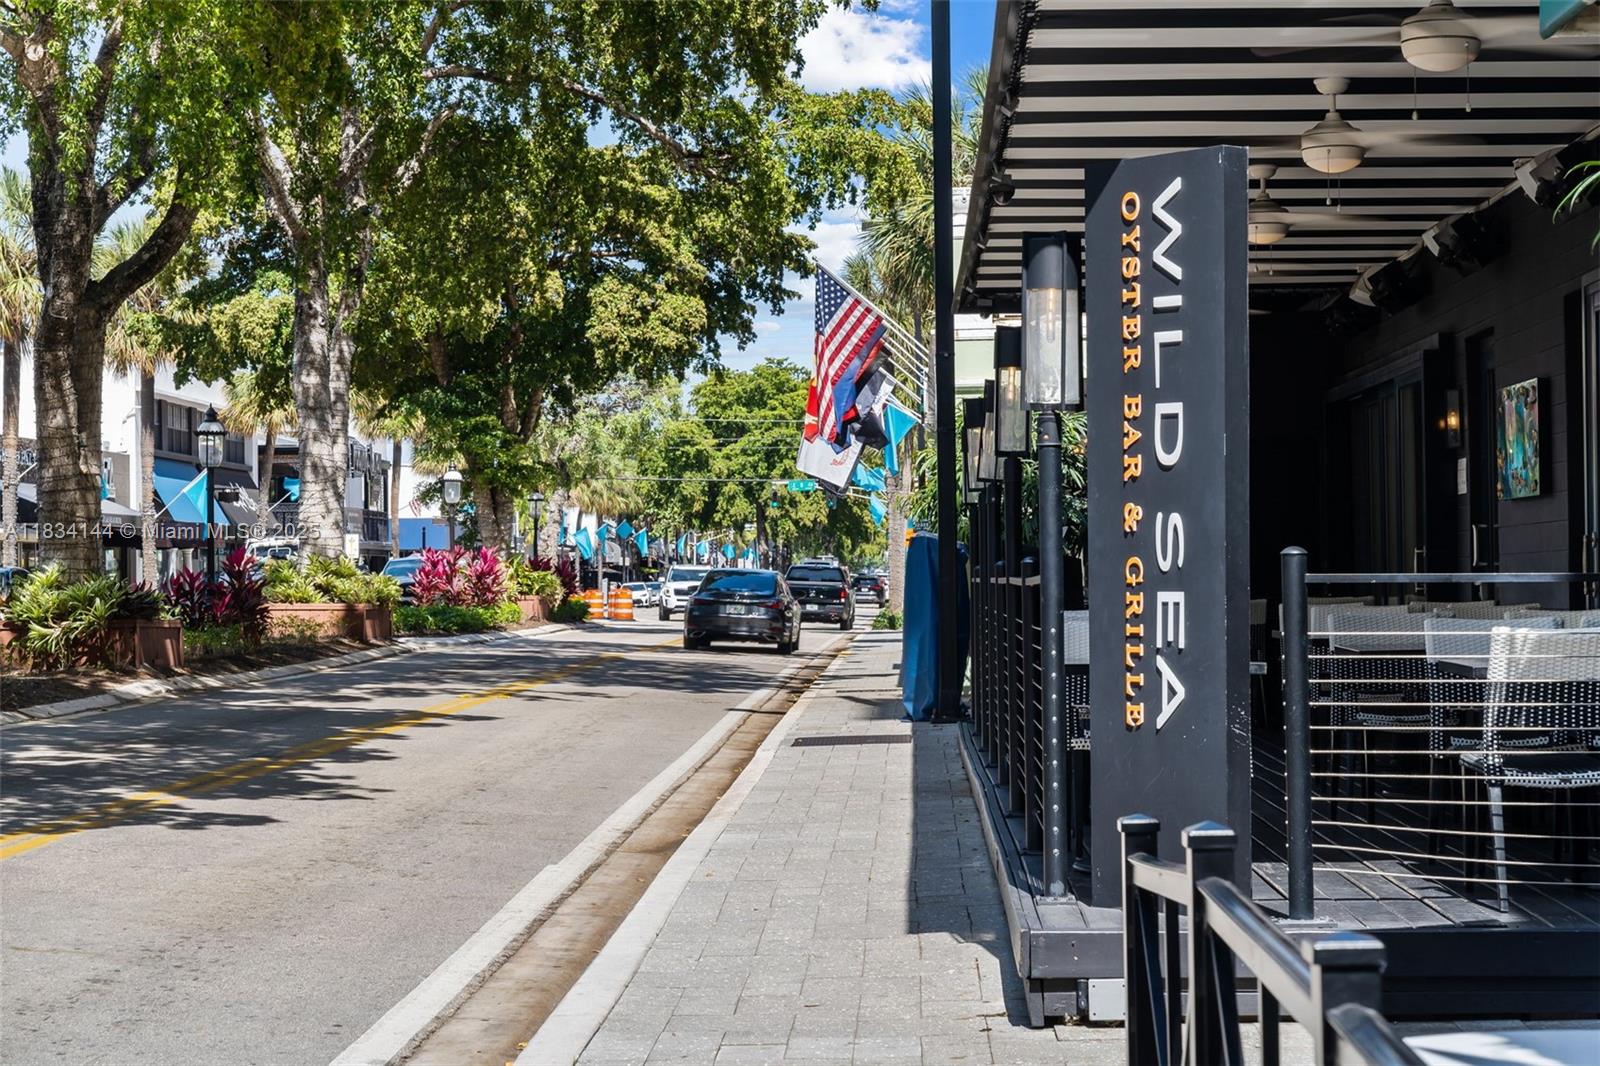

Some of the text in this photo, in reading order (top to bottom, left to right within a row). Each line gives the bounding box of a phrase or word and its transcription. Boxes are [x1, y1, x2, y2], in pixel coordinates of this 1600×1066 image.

[1121, 191, 1145, 728] OYSTER BAR & GRILLE
[1152, 176, 1186, 730] WILD SEA
